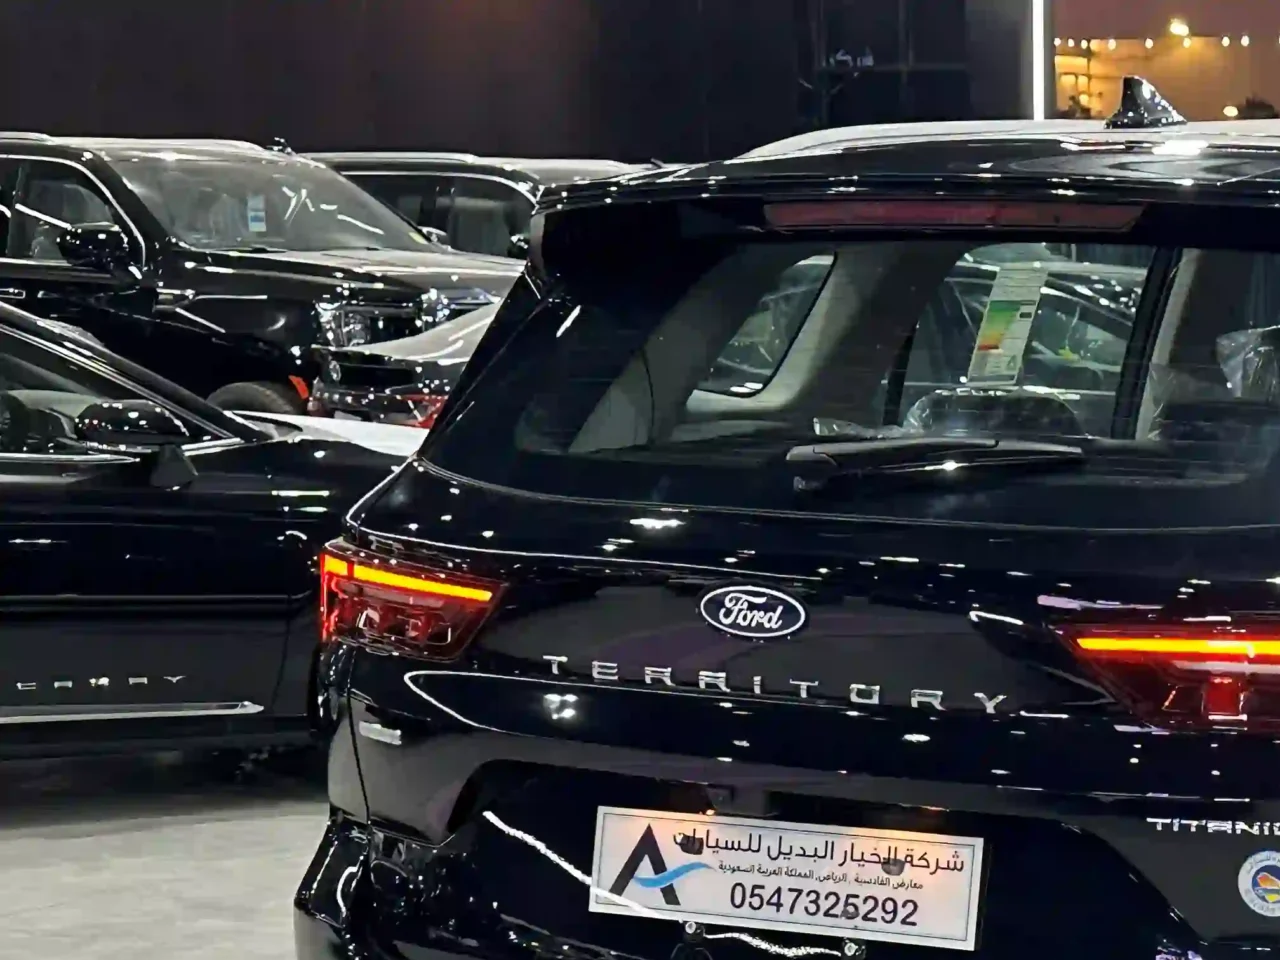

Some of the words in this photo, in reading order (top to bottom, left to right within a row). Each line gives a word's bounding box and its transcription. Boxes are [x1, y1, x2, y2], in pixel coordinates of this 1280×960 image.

[719, 592, 783, 630] Ford
[542, 655, 1007, 714] TERRITORY
[767, 834, 835, 861] البديل
[838, 842, 899, 868] الخيار
[903, 847, 965, 875] شركة
[730, 881, 919, 927] 0547325292
